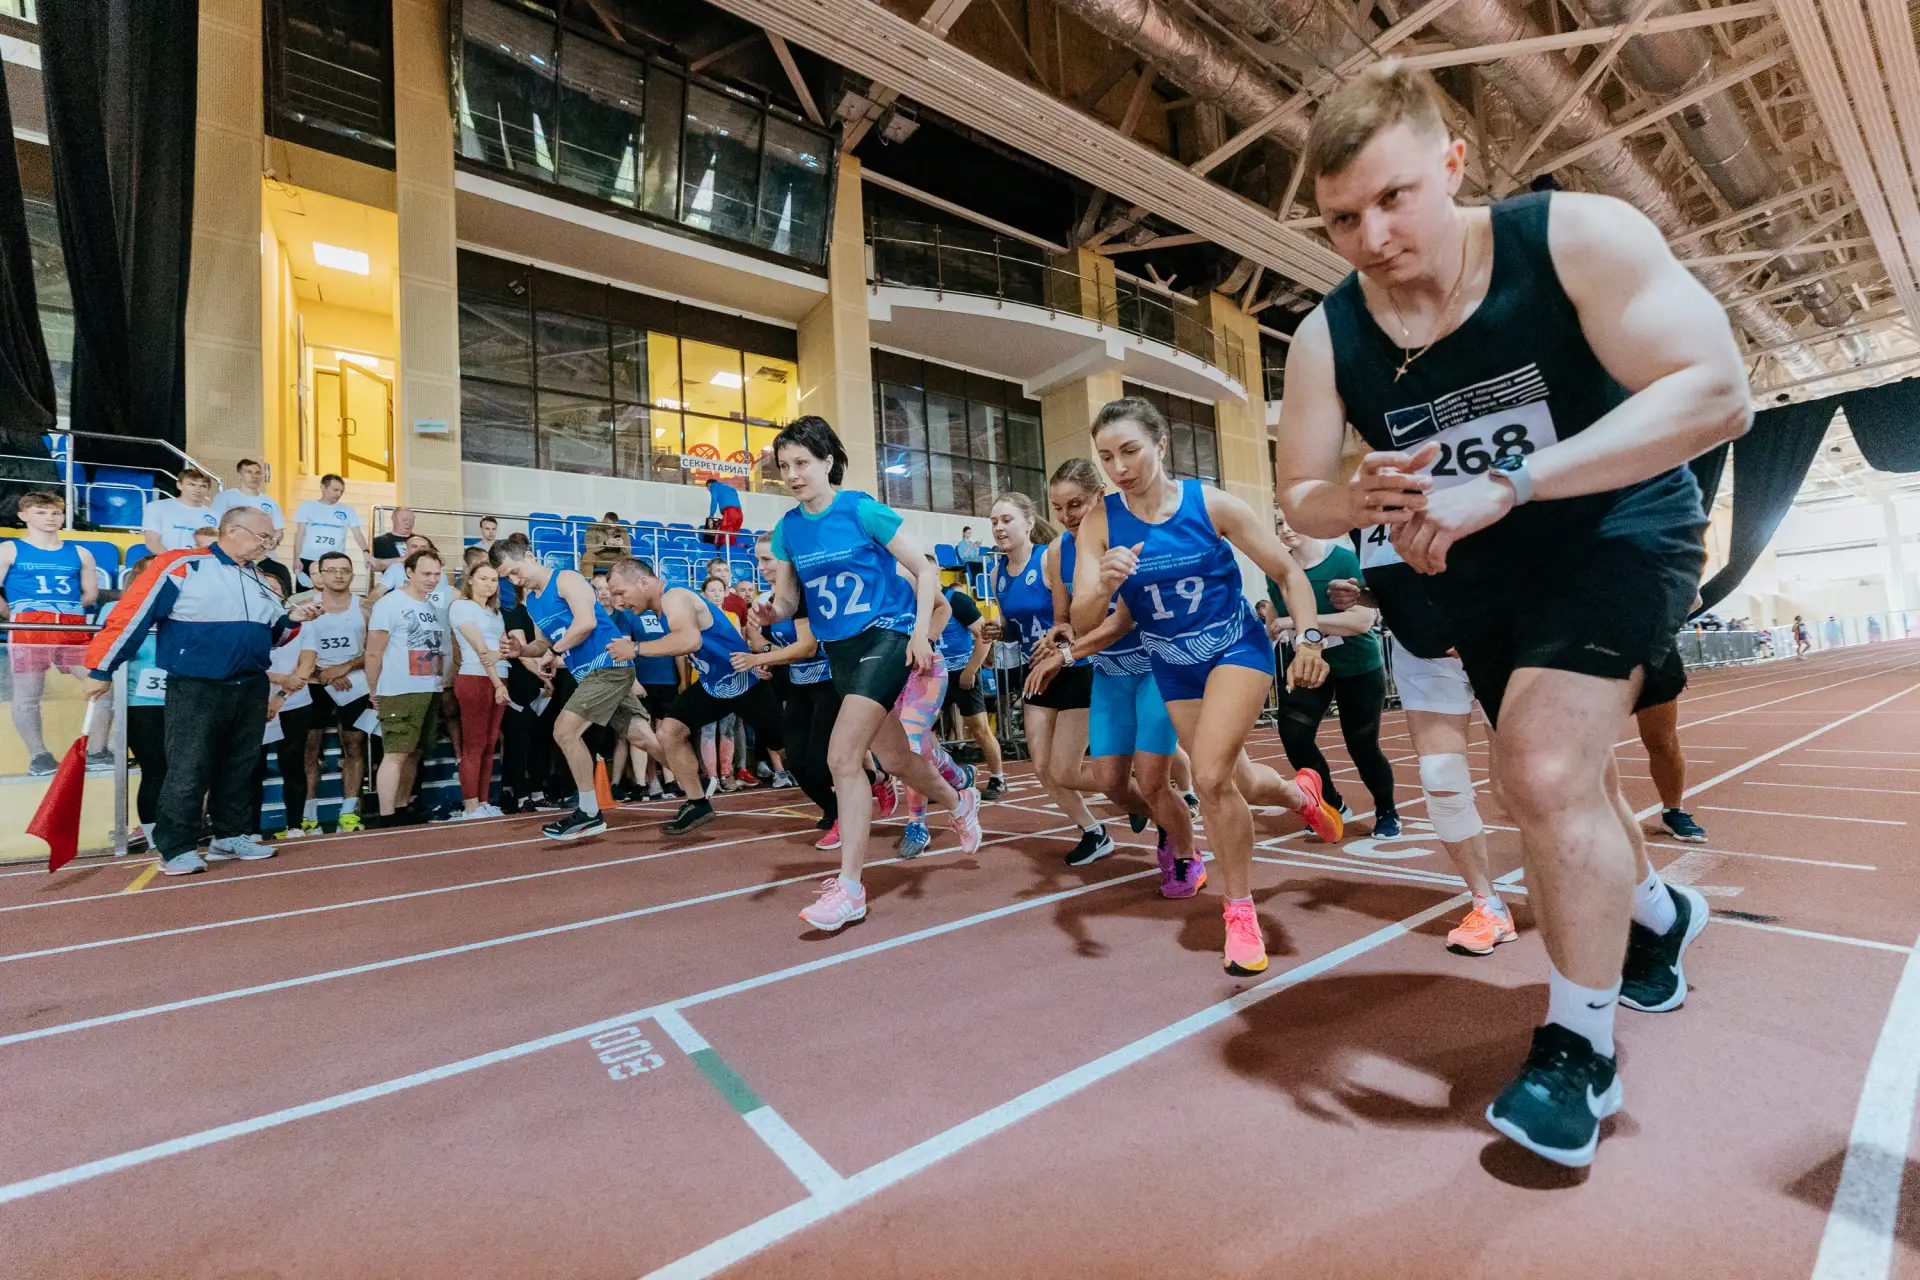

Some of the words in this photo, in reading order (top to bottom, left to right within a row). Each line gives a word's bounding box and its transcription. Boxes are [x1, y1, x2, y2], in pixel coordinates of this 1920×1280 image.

[1430, 423, 1535, 477] 268
[682, 458, 750, 476] СЕКРЕТАРИАТ
[315, 535, 336, 546] 278
[35, 575, 72, 595] 13
[805, 571, 871, 620] 32
[1143, 576, 1204, 620] 19
[1009, 613, 1048, 644] 14
[320, 636, 351, 650] 332
